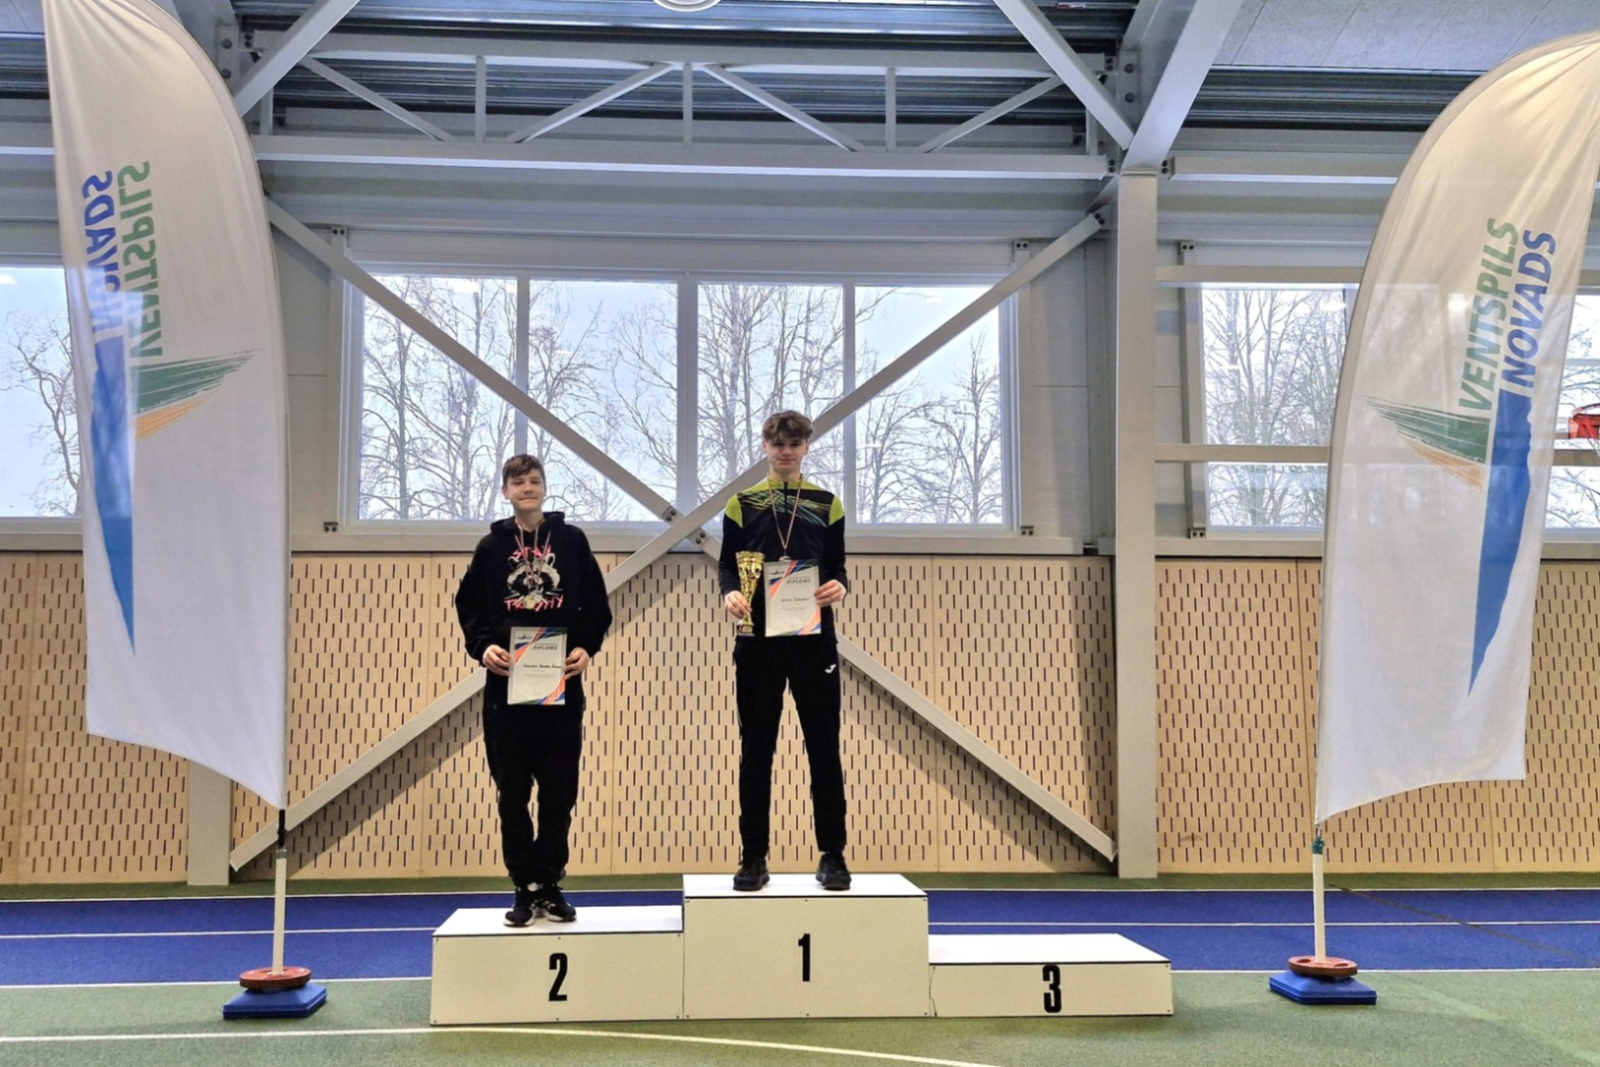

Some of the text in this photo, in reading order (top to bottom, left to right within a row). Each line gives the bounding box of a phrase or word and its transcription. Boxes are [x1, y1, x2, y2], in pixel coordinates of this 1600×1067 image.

[1459, 218, 1519, 411] VENTSPILS
[1502, 230, 1556, 388] NOVADS
[504, 594, 564, 612] TRSHY
[548, 952, 567, 1003] 2
[797, 932, 811, 982] 1
[1041, 964, 1062, 1014] 3
